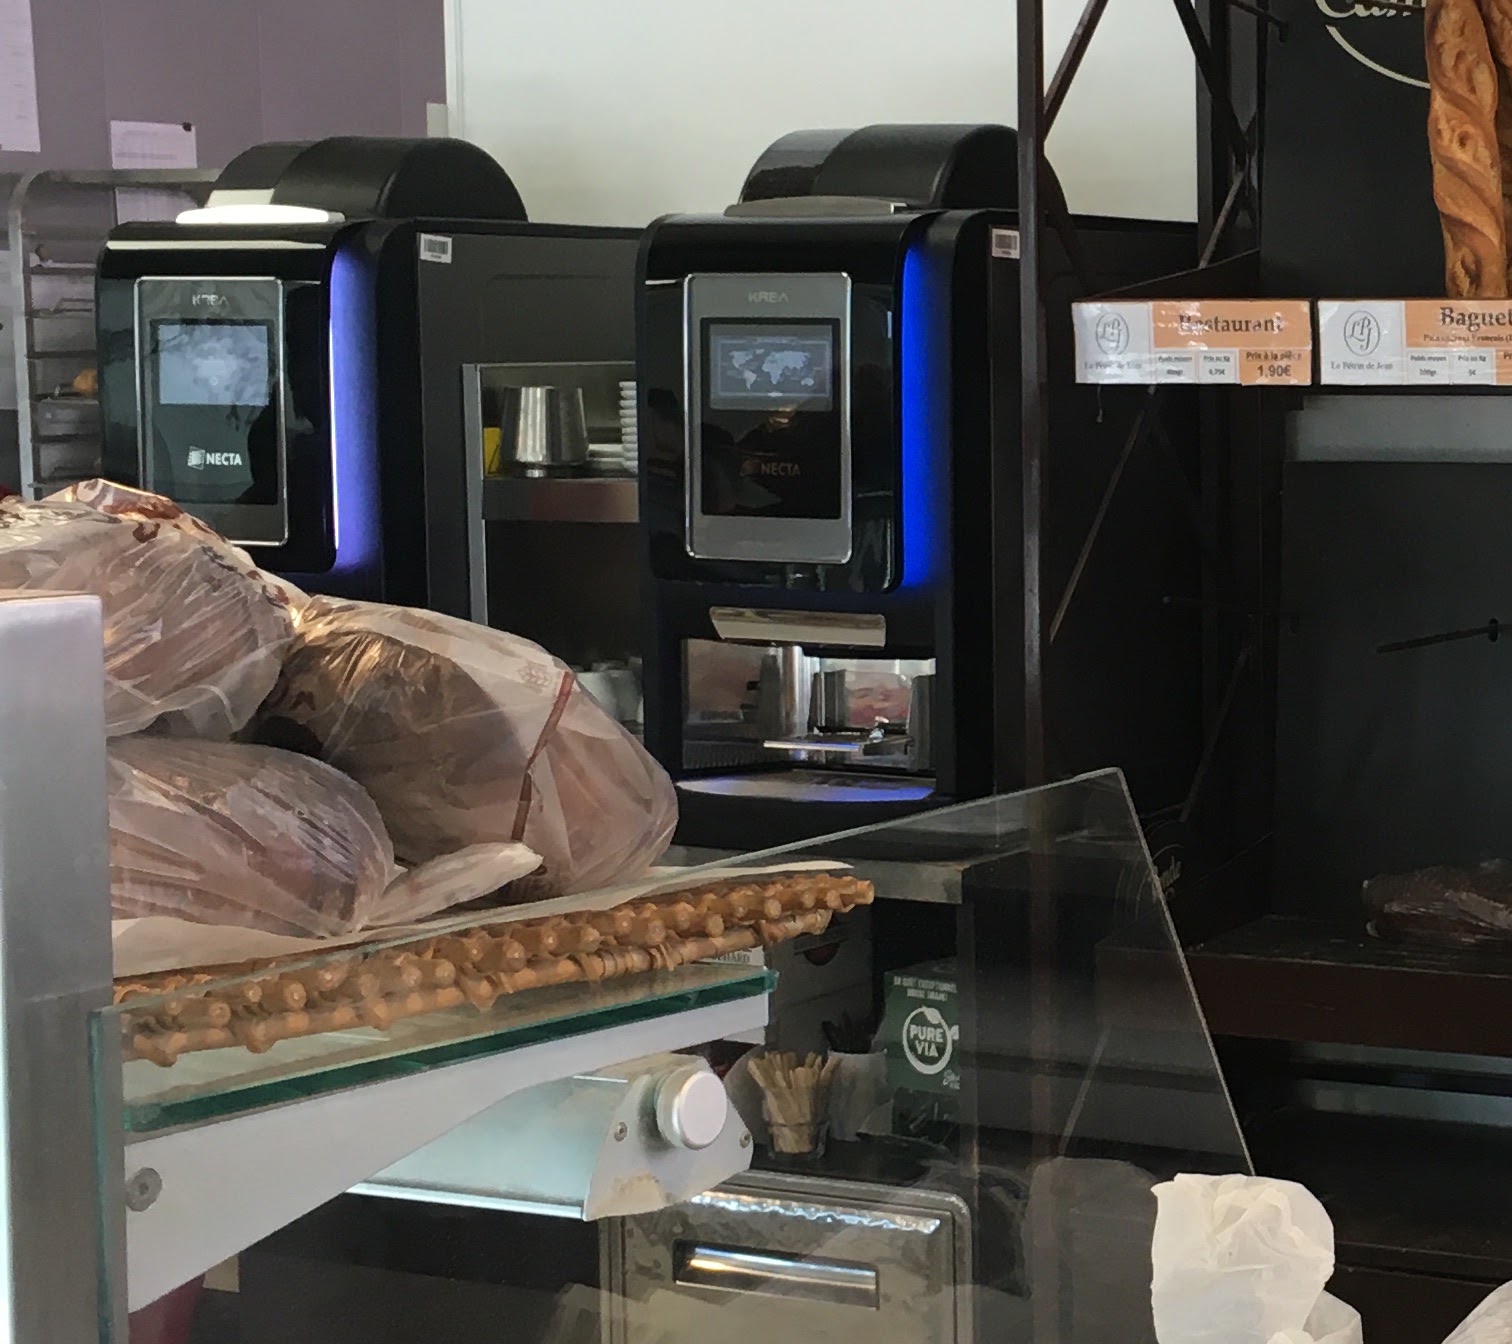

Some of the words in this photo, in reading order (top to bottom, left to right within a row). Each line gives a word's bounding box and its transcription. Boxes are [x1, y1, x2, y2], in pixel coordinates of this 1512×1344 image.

[748, 292, 789, 304] KREA
[1257, 364, 1292, 379] 1,90€
[206, 453, 242, 466] NECTA
[761, 463, 801, 477] NECTA
[909, 1023, 944, 1043] PURE
[914, 1040, 939, 1057] VIA
